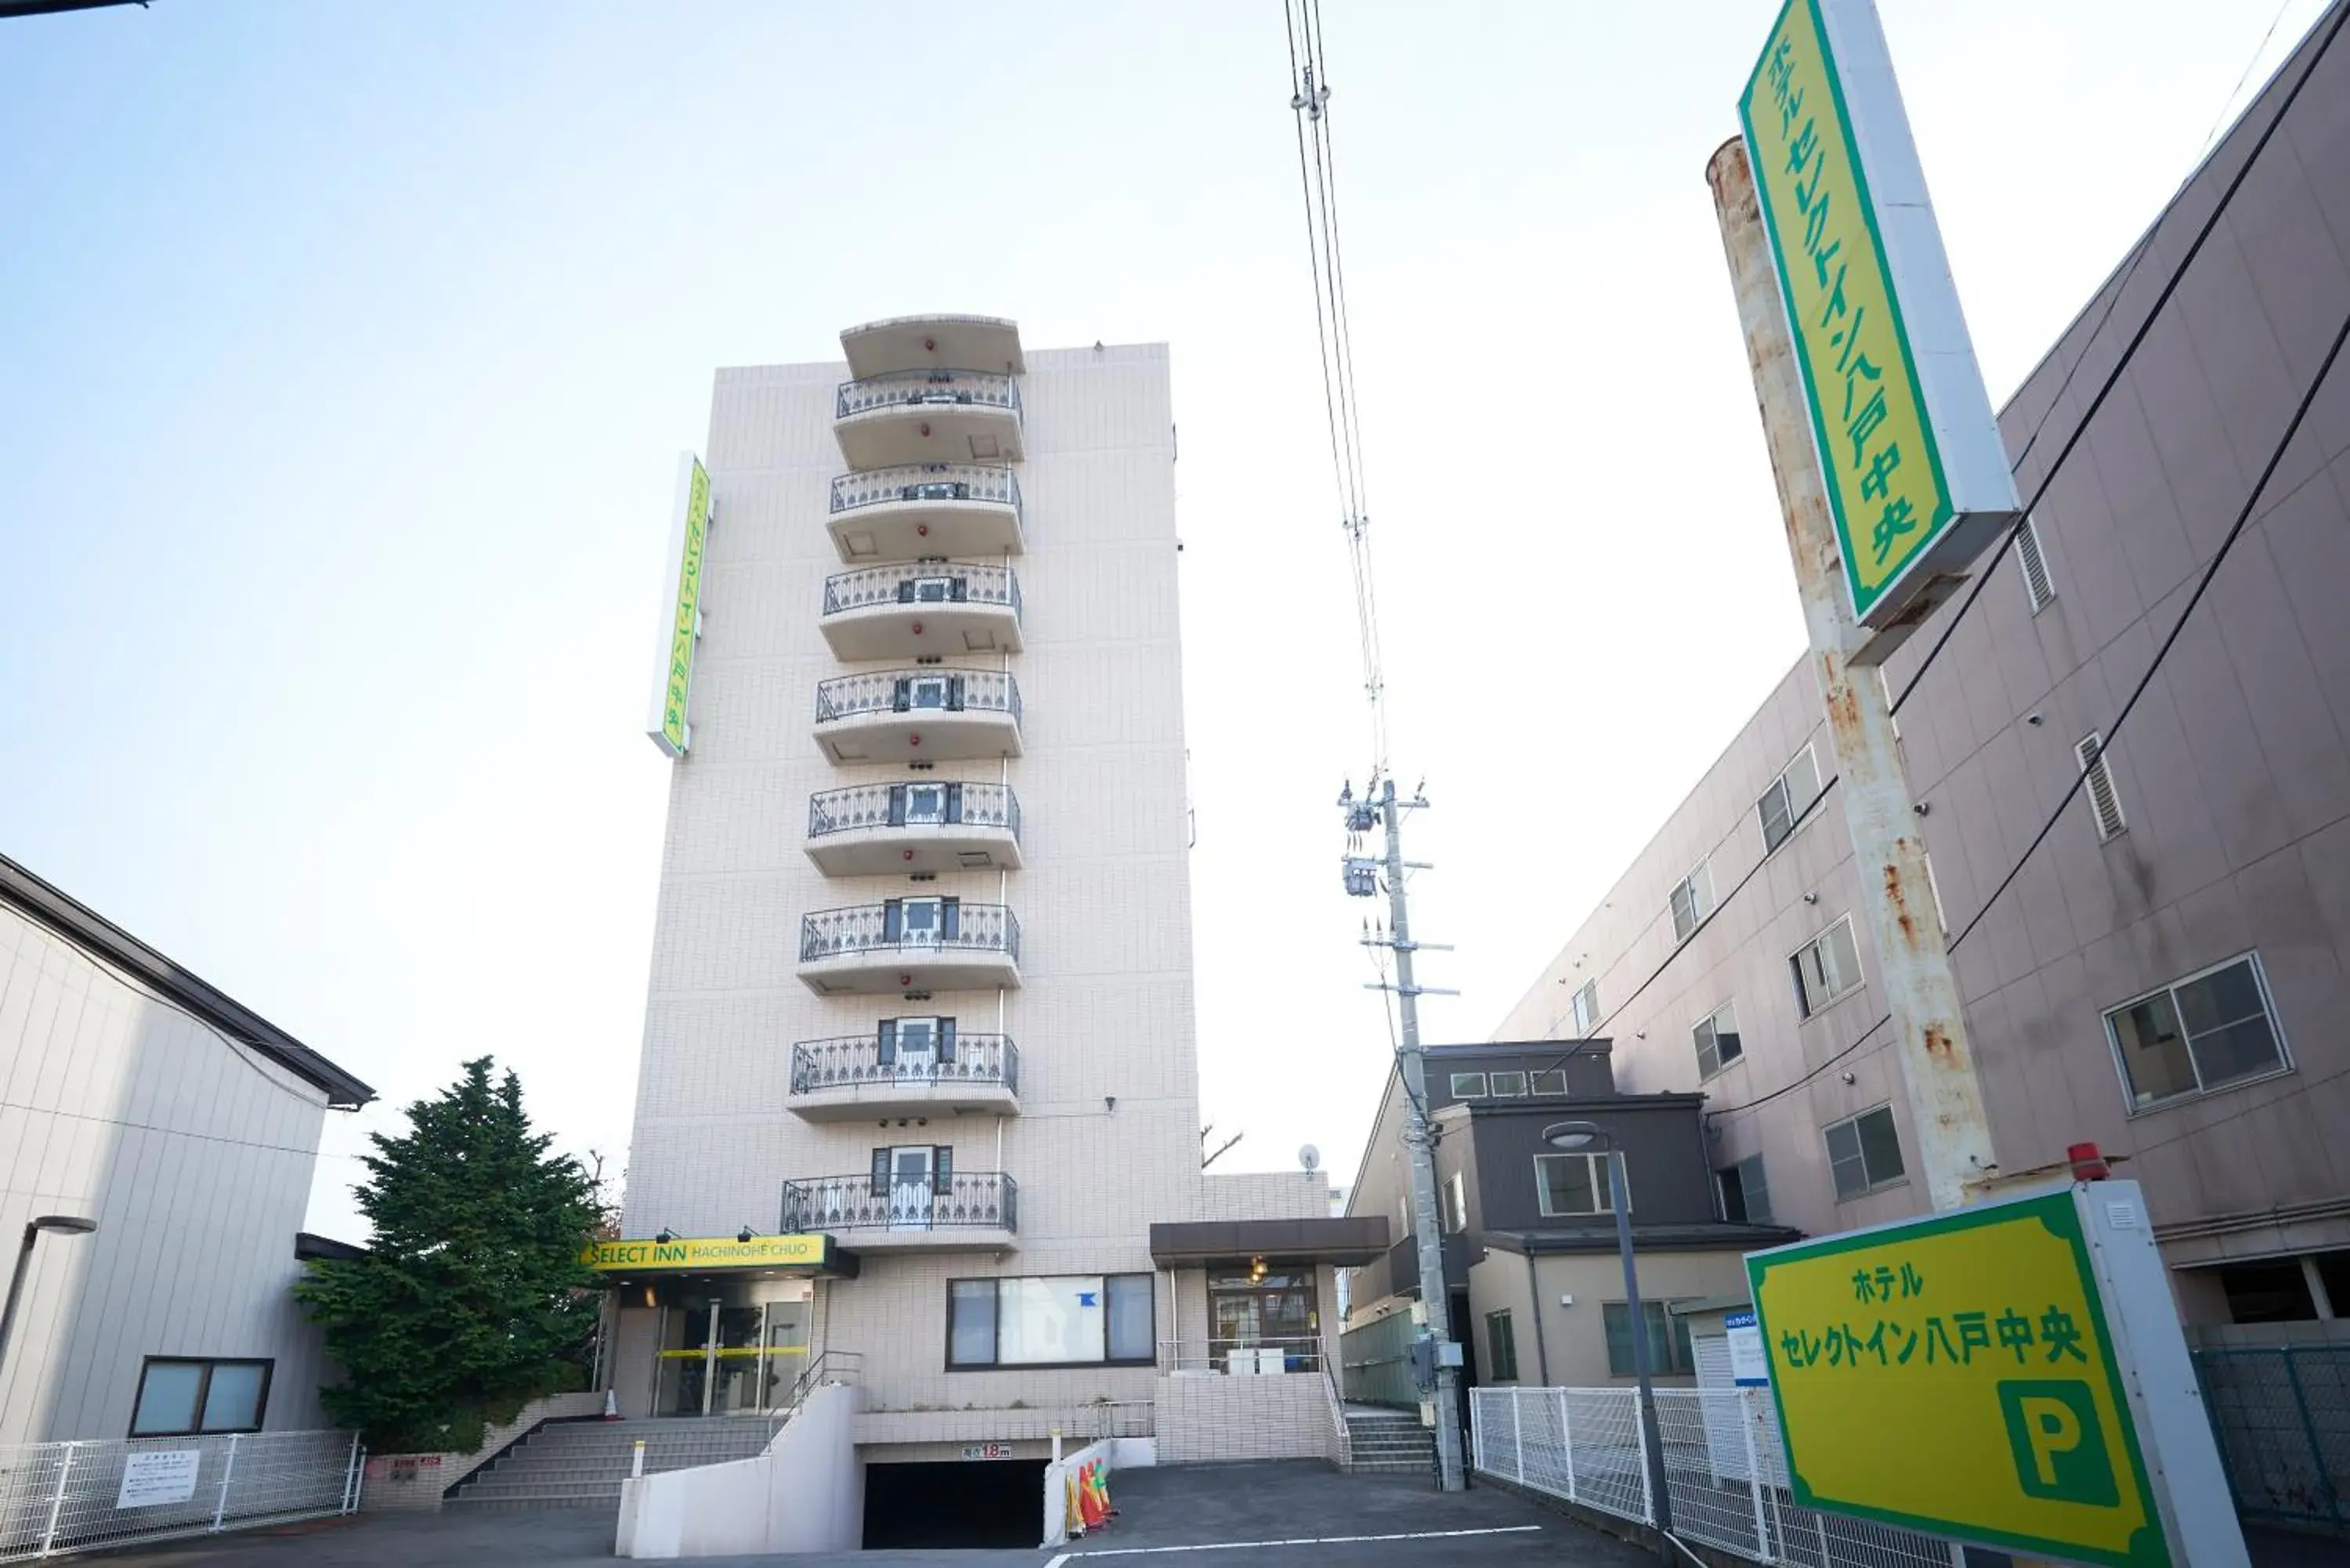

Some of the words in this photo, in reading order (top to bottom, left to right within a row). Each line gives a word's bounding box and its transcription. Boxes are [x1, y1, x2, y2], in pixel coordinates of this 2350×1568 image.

[591, 1241, 648, 1264] SELECT
[653, 1244, 687, 1263] INN
[692, 1244, 768, 1259] HACHINOHE
[769, 1242, 808, 1255] CHUO
[1852, 1260, 1923, 1305] ホテル
[1781, 1304, 2088, 1367] セレクトイン八戸中央
[2019, 1396, 2081, 1486] P
